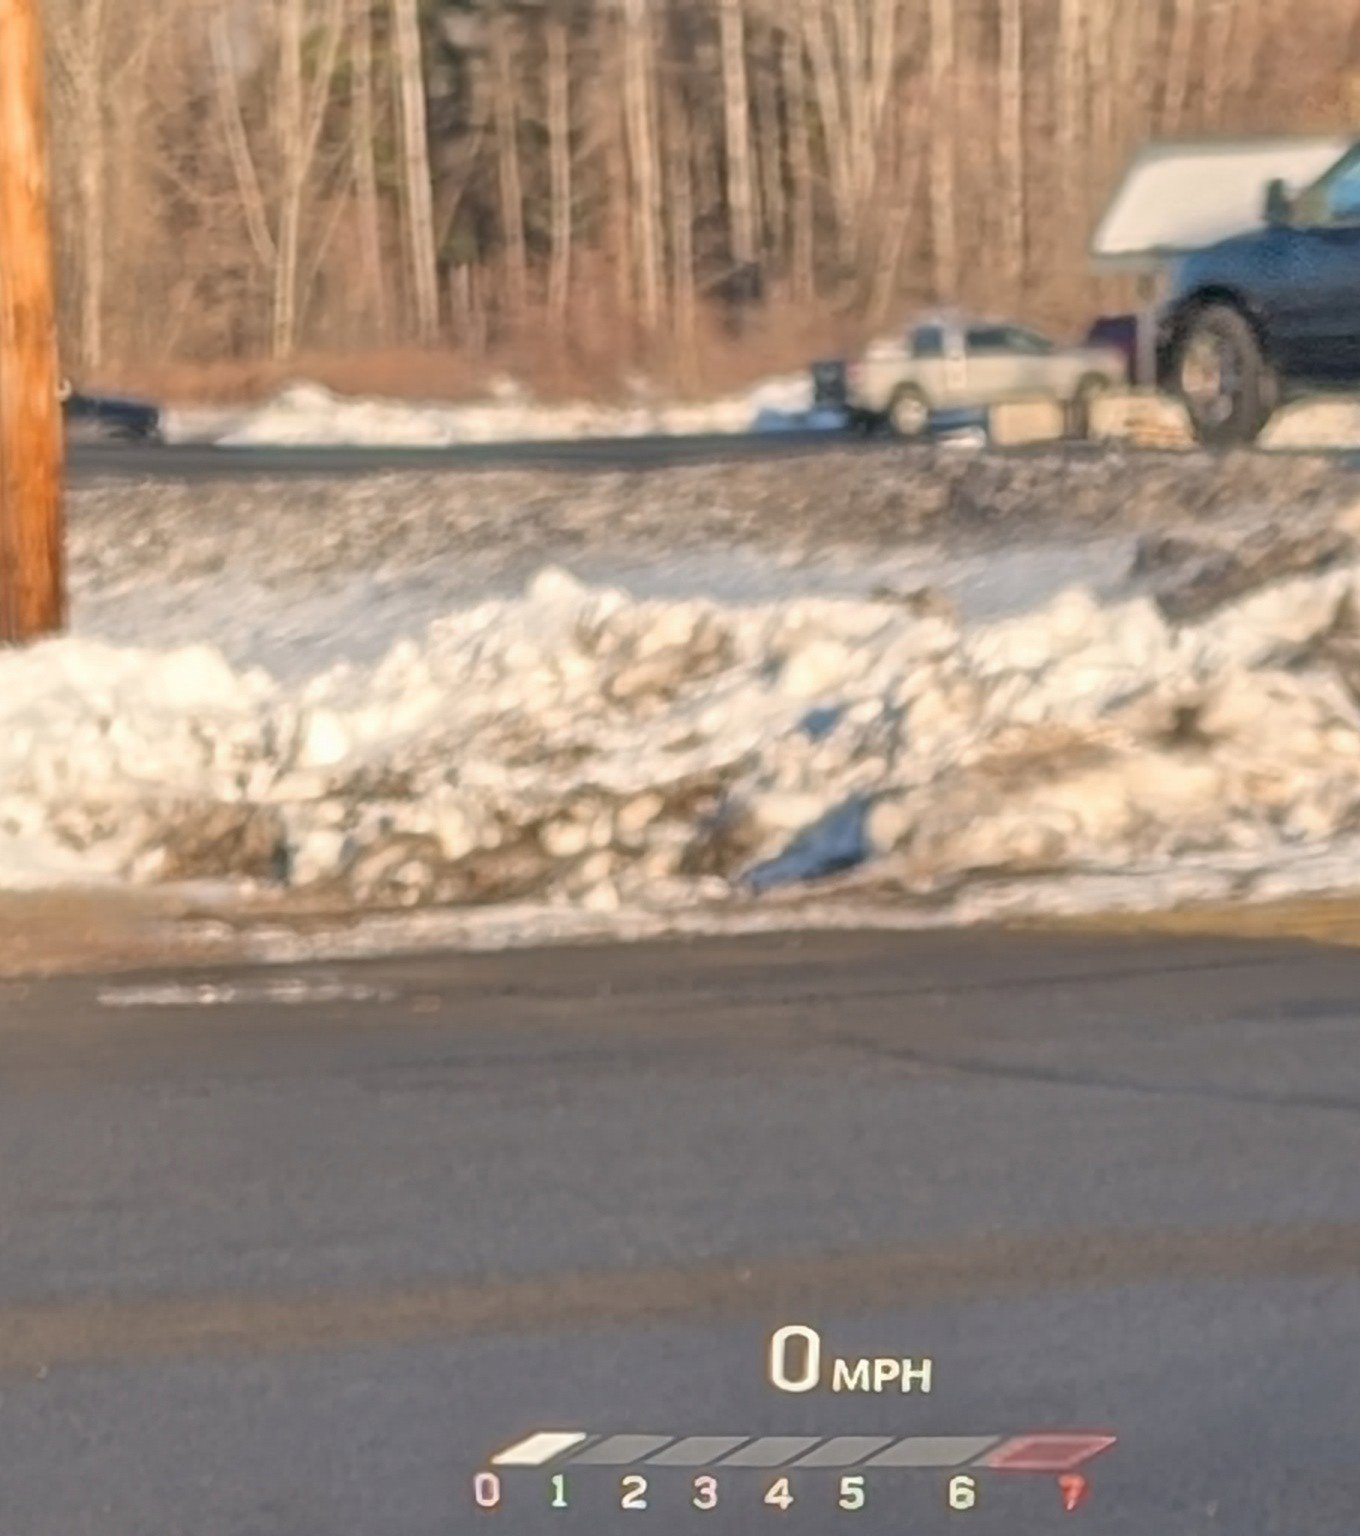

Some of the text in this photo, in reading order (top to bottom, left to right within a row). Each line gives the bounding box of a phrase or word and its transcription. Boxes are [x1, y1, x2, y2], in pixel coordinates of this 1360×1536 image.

[771, 1325, 932, 1392] 0 MPH
[475, 1472, 1086, 1510] 0 1 2 3 4 5 6 7
